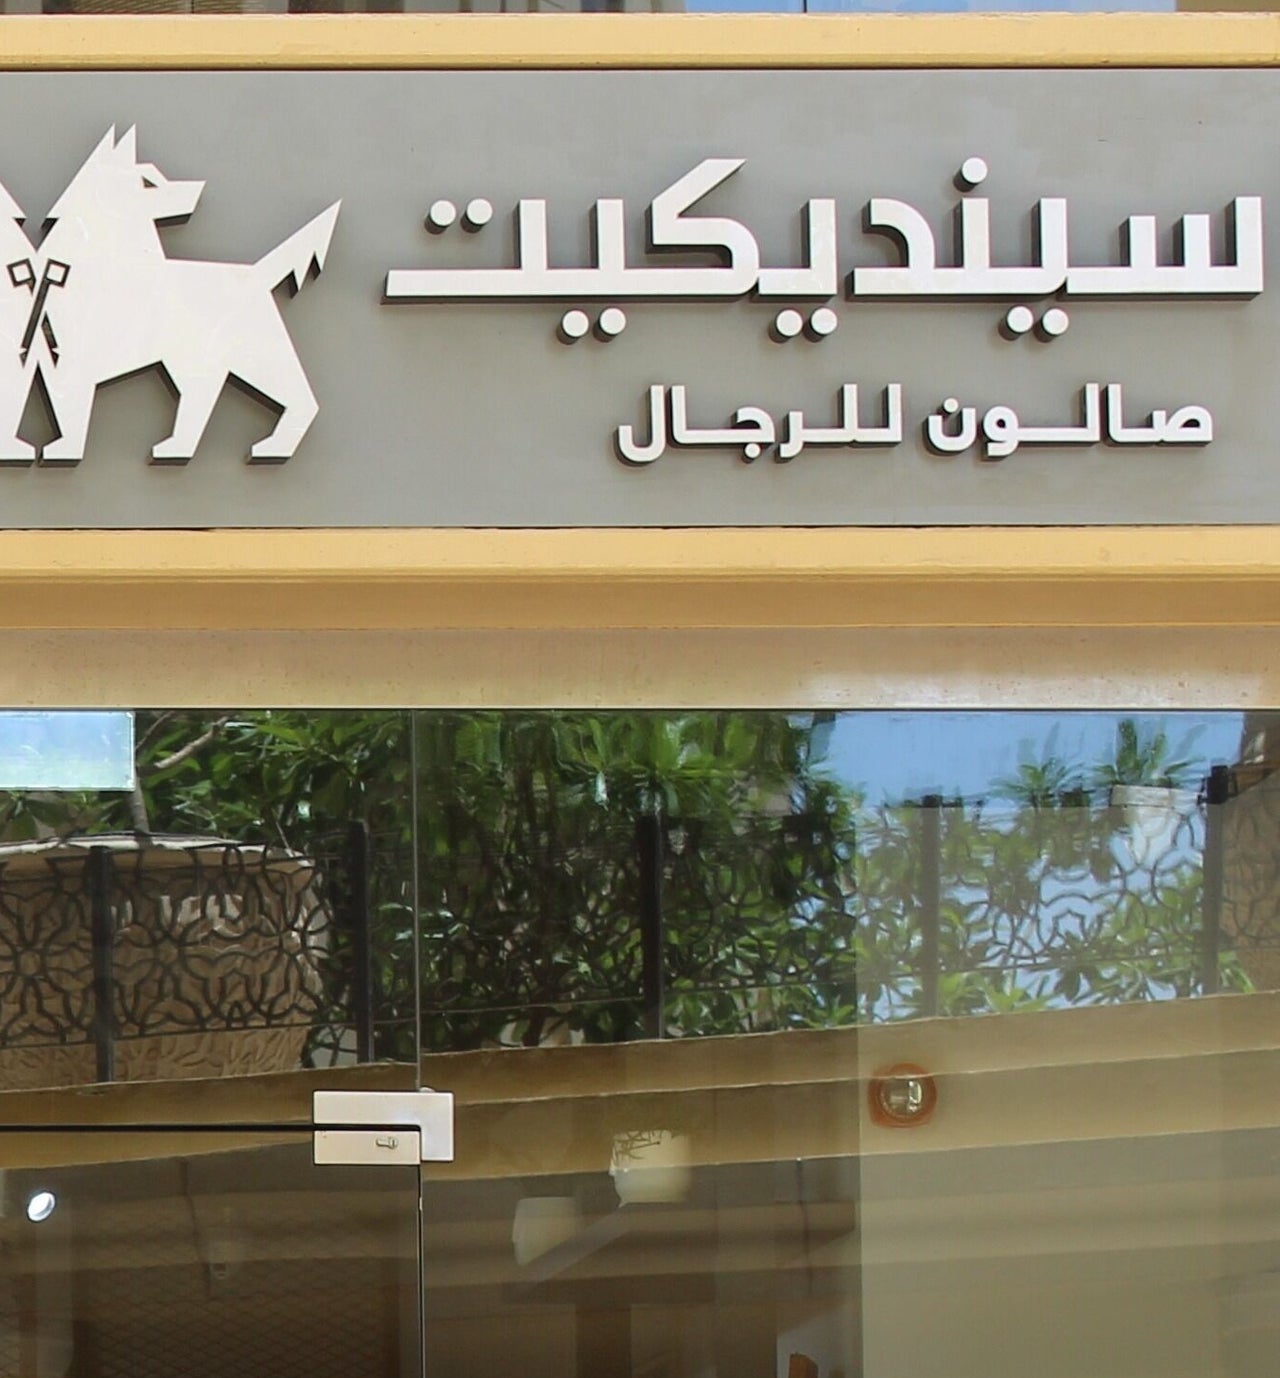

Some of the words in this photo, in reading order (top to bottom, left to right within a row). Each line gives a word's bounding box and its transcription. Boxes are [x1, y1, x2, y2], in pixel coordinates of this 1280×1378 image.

[385, 156, 1265, 338] سينديكيت
[618, 383, 903, 463] للرجال
[928, 383, 1213, 457] صالون
